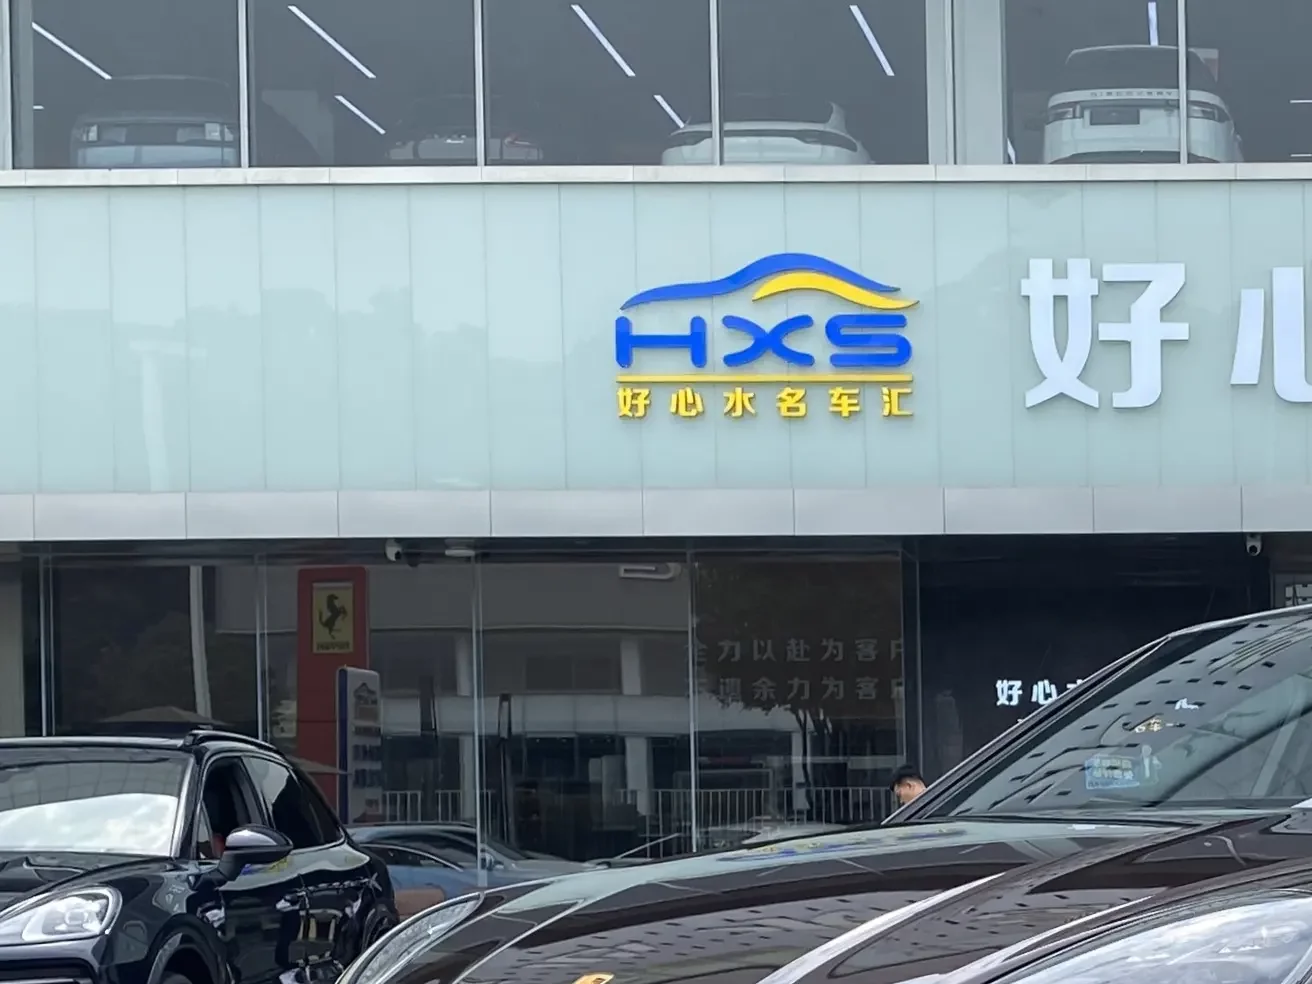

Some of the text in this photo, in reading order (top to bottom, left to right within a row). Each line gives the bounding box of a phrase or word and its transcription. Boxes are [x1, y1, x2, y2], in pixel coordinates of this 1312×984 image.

[615, 314, 912, 368] HXS
[617, 386, 913, 418] 好心水名车汇
[996, 679, 1085, 706] 好心
